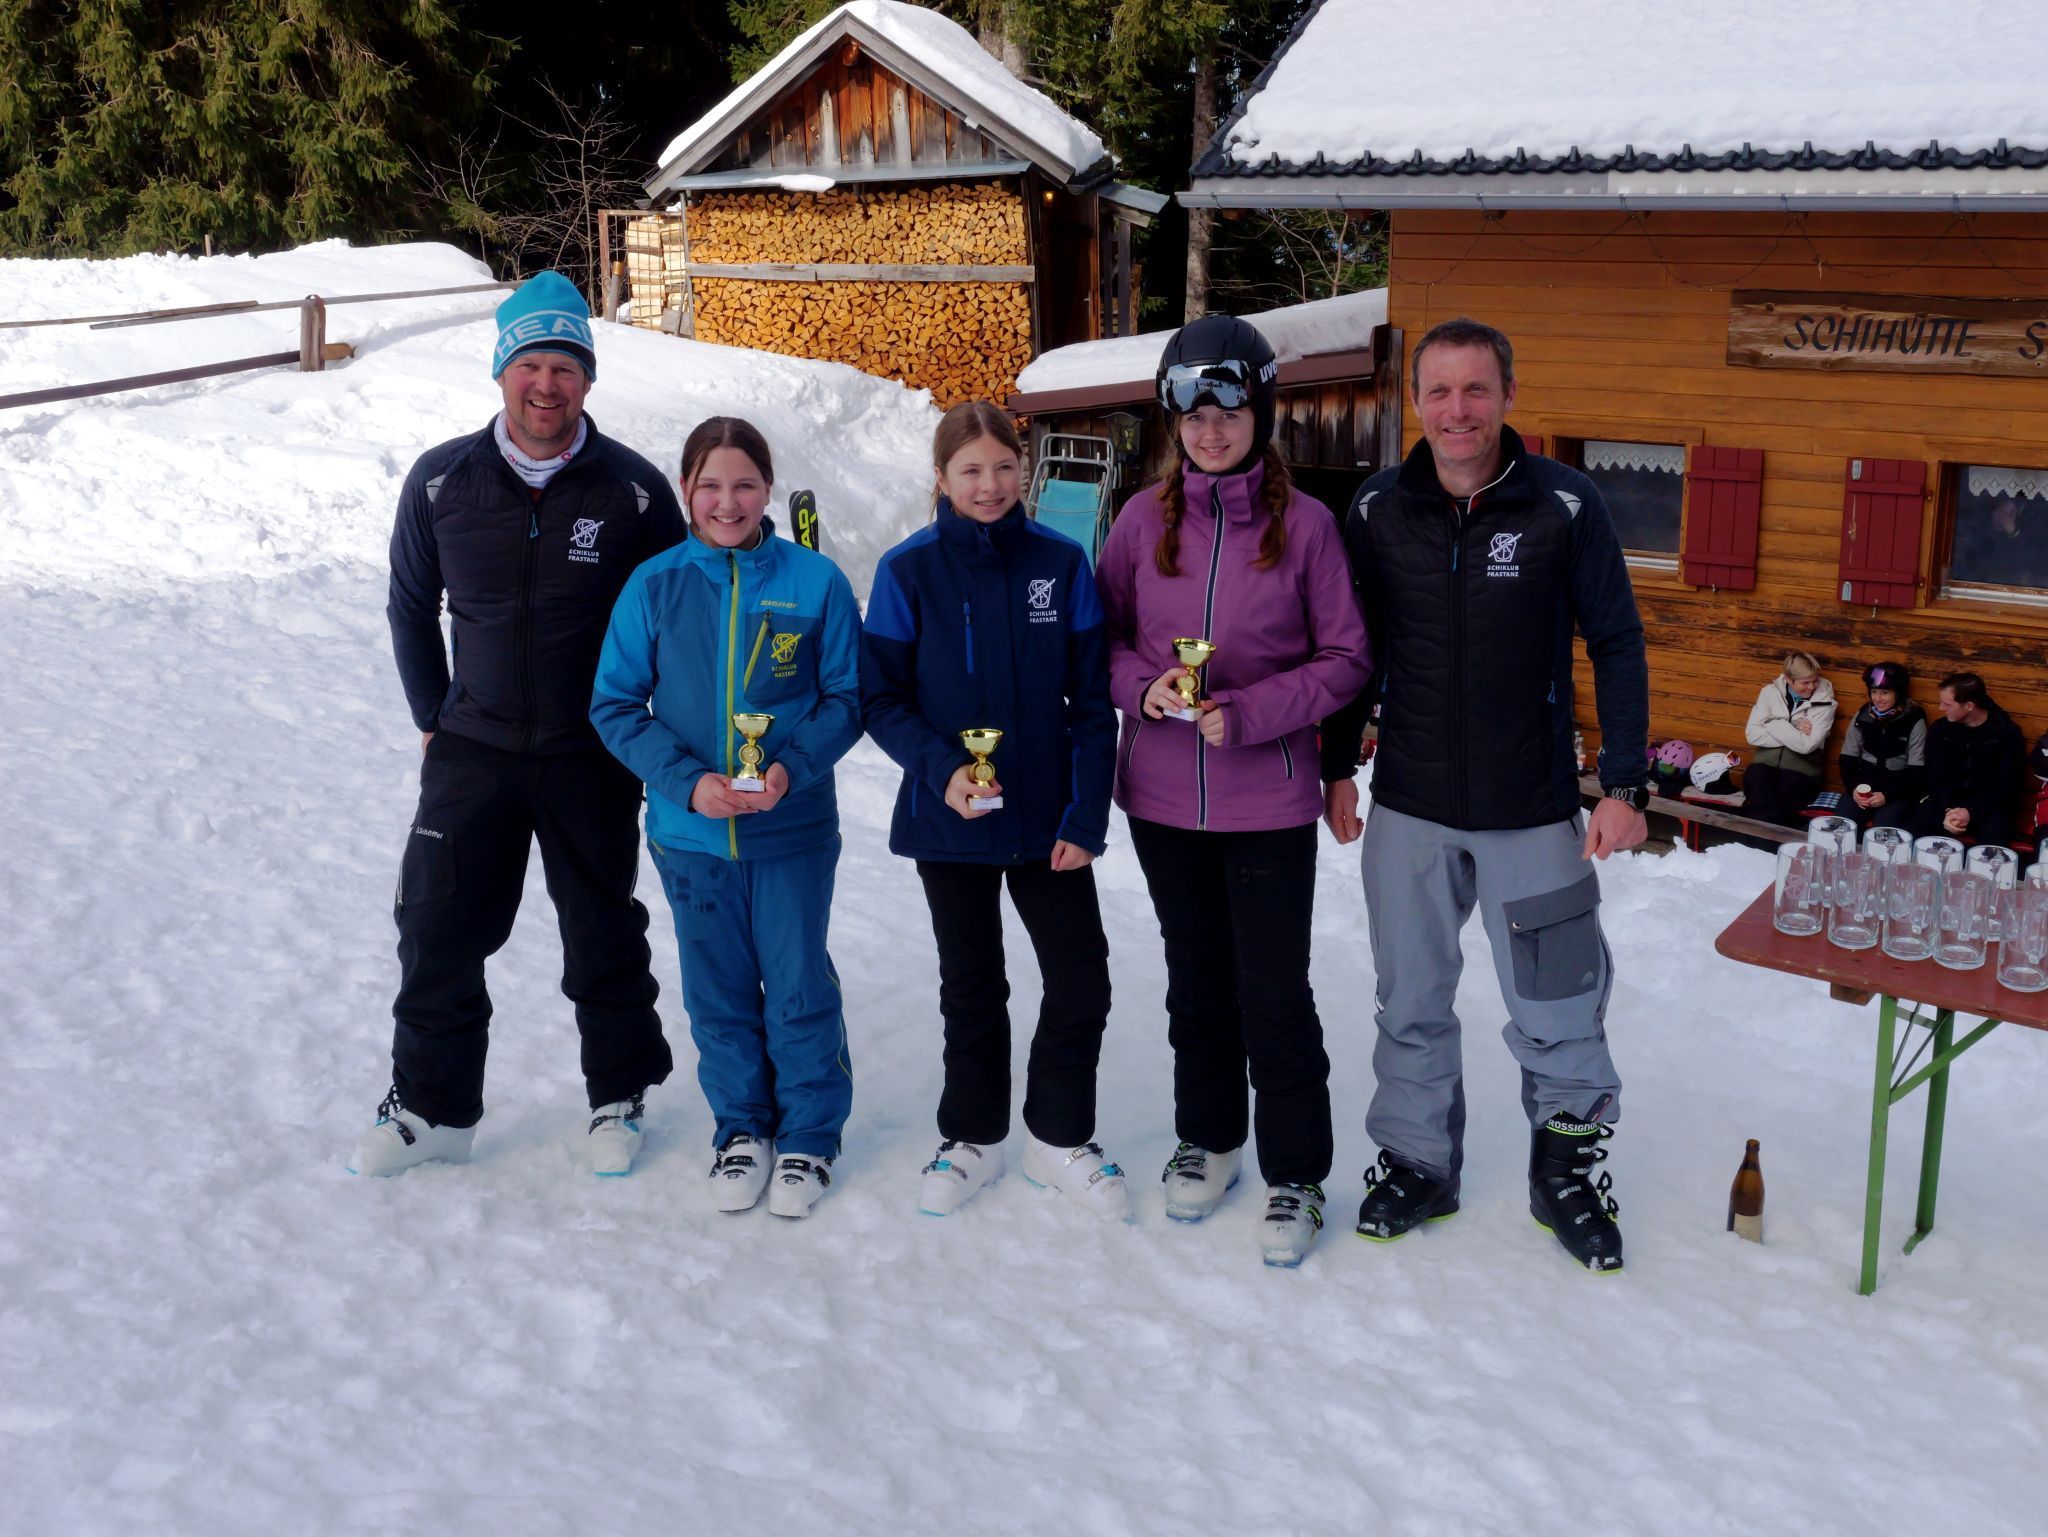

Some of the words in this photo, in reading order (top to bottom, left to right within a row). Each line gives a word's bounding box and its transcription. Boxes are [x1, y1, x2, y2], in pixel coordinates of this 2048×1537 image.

[1783, 315, 1982, 358] SCHIHÜTTE
[568, 548, 600, 557] SCHIKLUB
[568, 555, 599, 563] FRASTANZ
